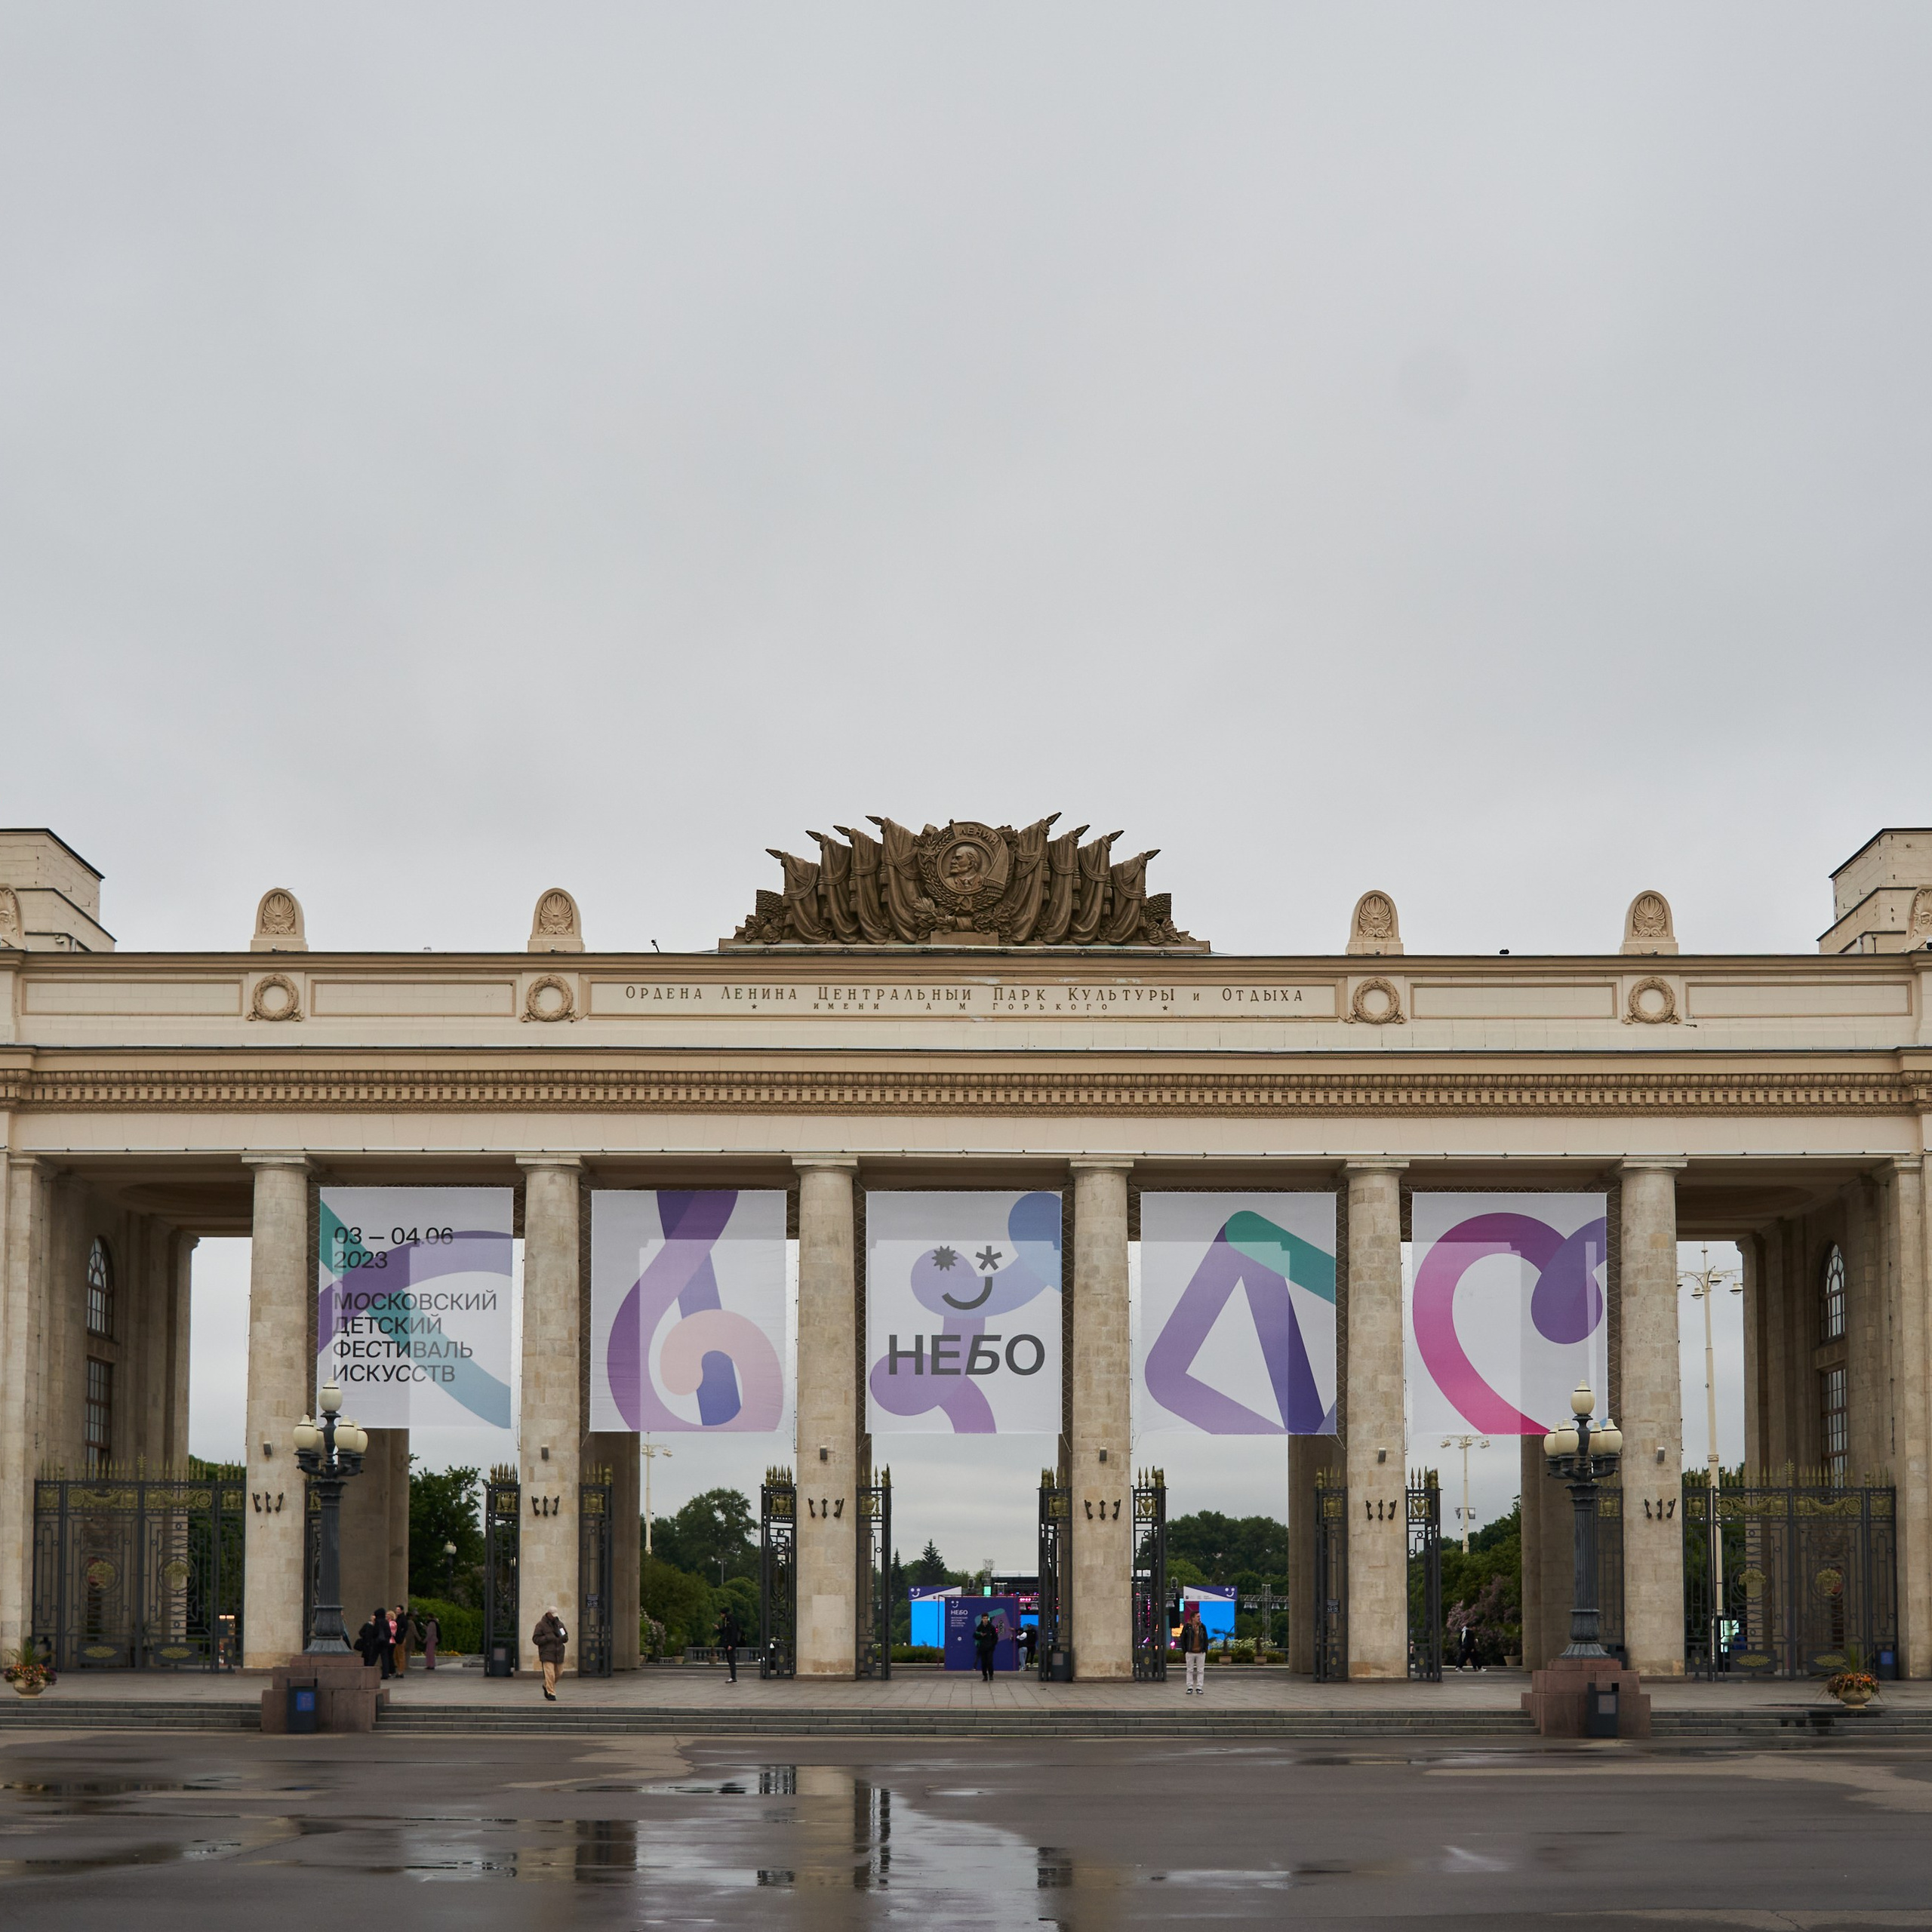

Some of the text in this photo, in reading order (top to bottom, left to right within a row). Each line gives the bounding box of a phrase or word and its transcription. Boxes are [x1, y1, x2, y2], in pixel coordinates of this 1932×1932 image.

[959, 827, 1000, 845] ЛЕНИН
[334, 1226, 362, 1245] 03
[334, 1251, 388, 1269] 2023
[334, 1290, 497, 1311] МОСКОВСКИЙ
[333, 1313, 442, 1337] ДЕТСКИЙ
[333, 1340, 473, 1358] ФЕСТИВАЛЬ
[888, 1334, 1045, 1376] НЕБО
[333, 1364, 455, 1383] ИСКУССТВ
